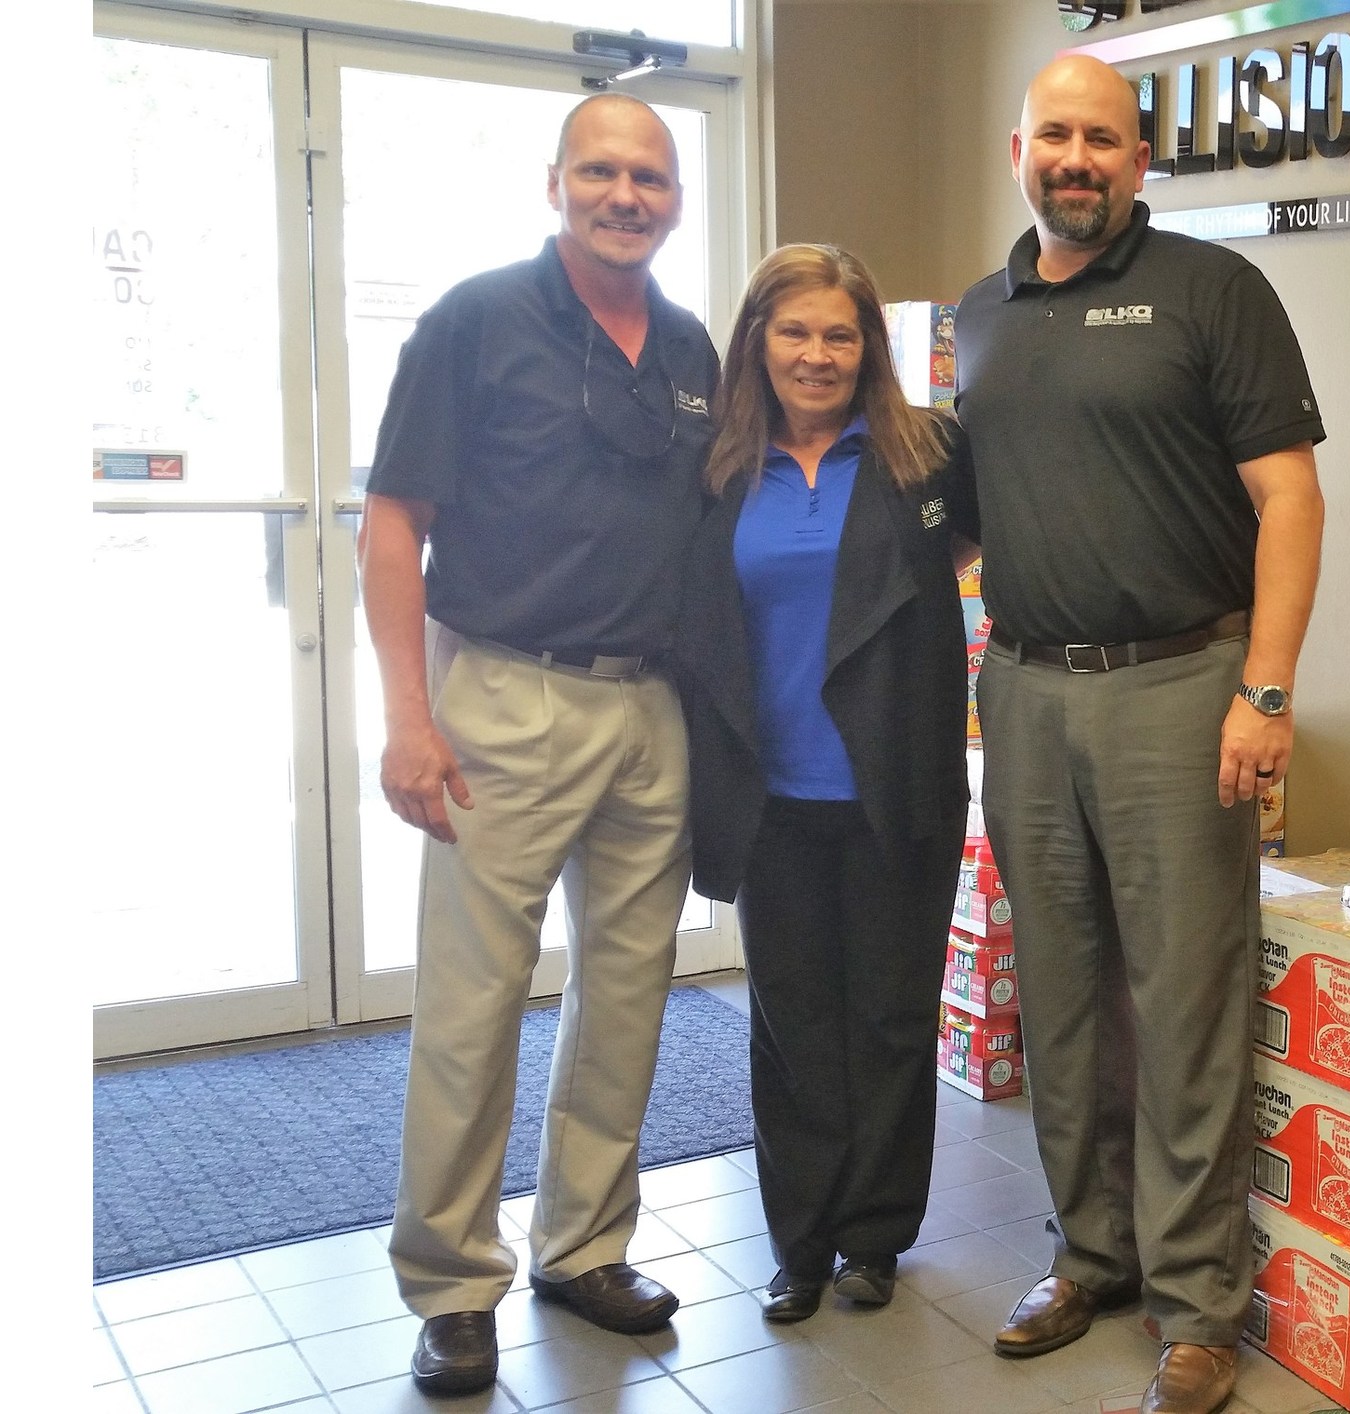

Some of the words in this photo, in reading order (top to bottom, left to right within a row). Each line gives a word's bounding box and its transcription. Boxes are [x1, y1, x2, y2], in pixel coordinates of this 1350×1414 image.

[1287, 203, 1331, 228] YOUR
[1104, 304, 1153, 320] LKQ
[950, 971, 968, 992] Jif
[986, 1034, 1013, 1052] Jif
[949, 1052, 966, 1073] Jif
[1306, 1276, 1339, 1305] Instant
